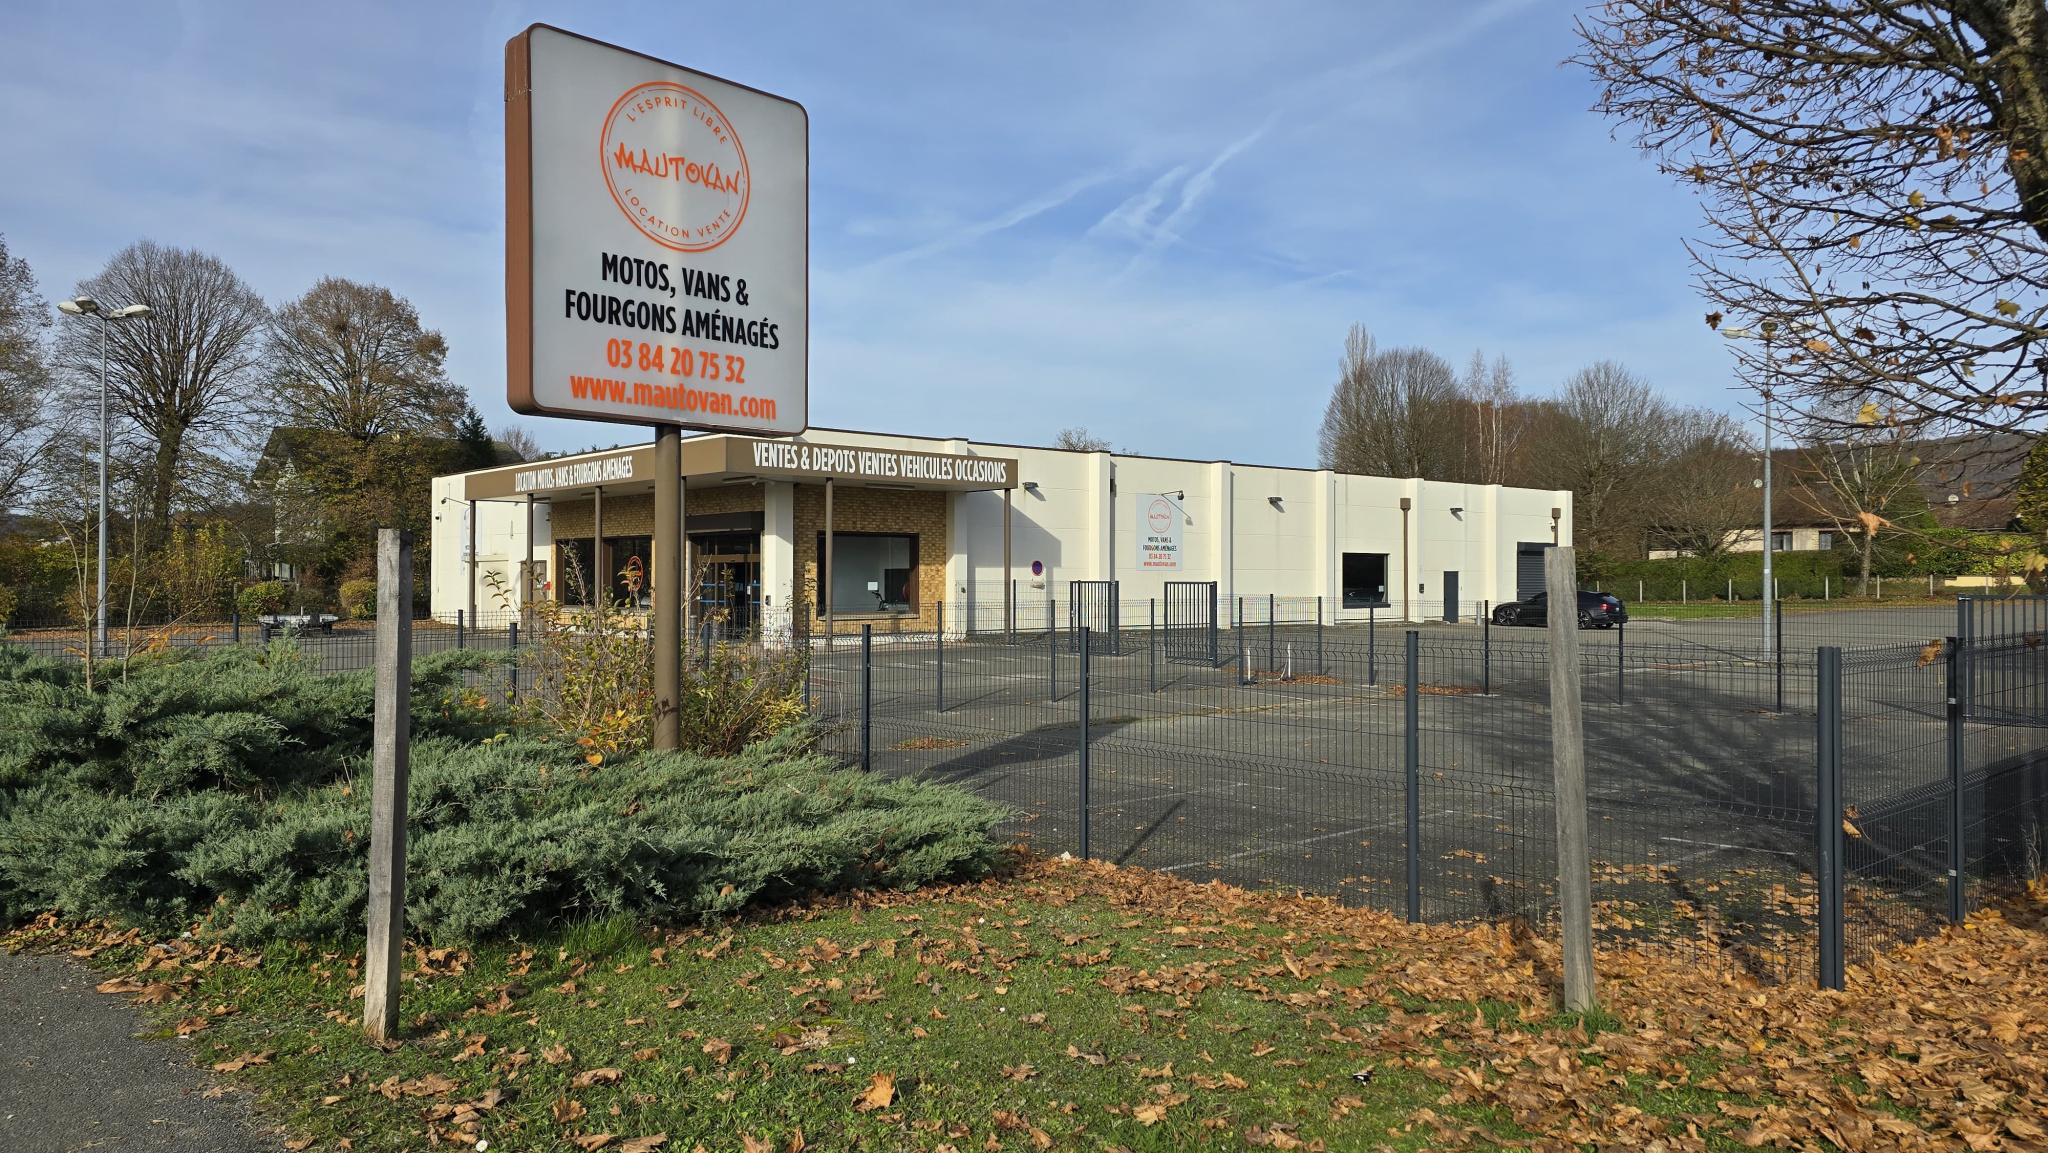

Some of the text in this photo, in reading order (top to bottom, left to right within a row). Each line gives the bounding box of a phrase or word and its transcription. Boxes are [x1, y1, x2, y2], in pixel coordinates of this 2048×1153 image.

[626, 96, 728, 144] L'ESPRIT LIBRE
[613, 142, 740, 195] MAUTOVAN
[624, 188, 731, 239] LOCATION VENTE
[601, 251, 750, 307] MOTOS, VANS &
[565, 288, 780, 350] FOURGONS AMÉNAGÉS
[606, 338, 746, 384] 03 84 20 75 32
[569, 375, 777, 420] www.mautovan.com
[515, 470, 537, 492] LOCATION
[555, 465, 569, 488] VANS
[569, 465, 574, 486] &
[574, 460, 602, 485] FOURGONS
[602, 455, 633, 481] AMENAGES
[752, 441, 1007, 484] VENTES & DEPOTS VENTES VEHICULES OCCASIONS
